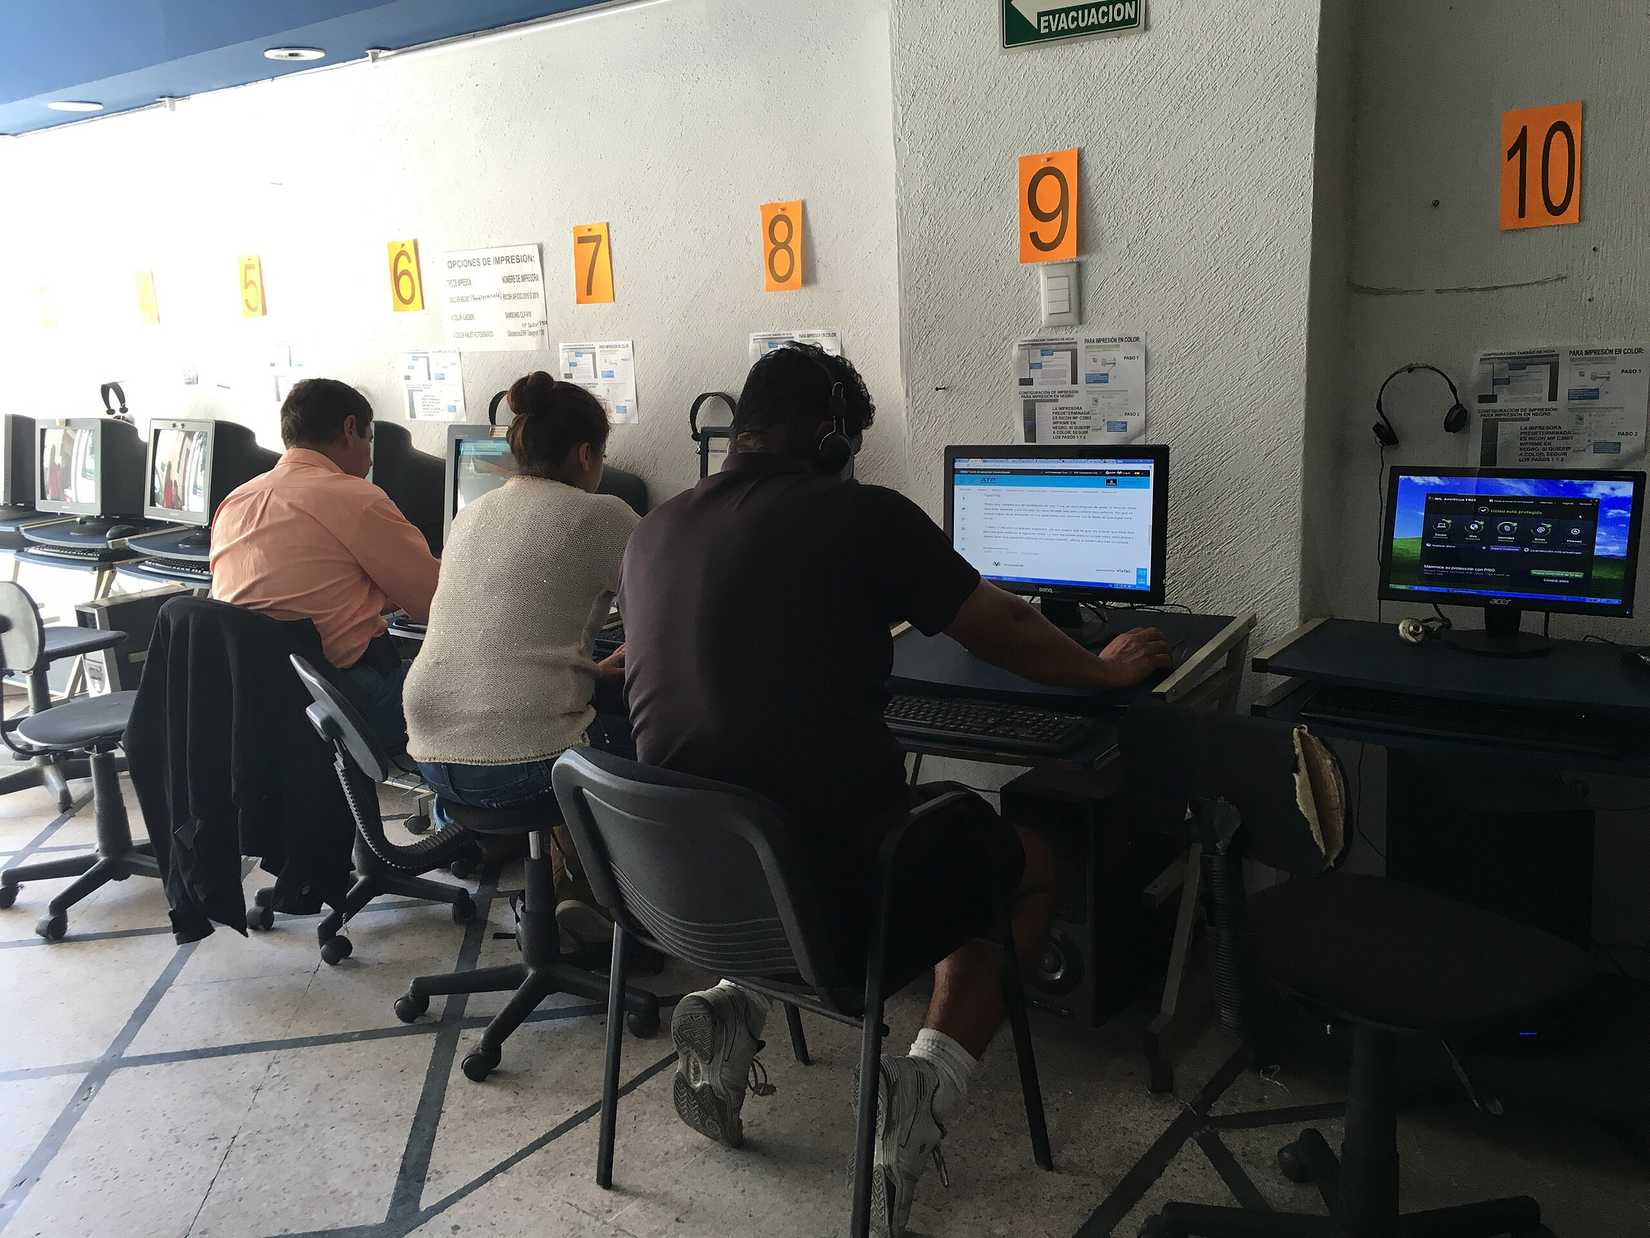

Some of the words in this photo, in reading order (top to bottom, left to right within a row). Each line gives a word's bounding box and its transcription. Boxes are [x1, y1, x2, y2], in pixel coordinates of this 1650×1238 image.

[1040, 1, 1136, 34] EVACUACION
[1507, 120, 1576, 219] 10
[1027, 166, 1069, 252] 9
[393, 250, 416, 305] 6
[447, 258, 481, 269] OPCIONES
[482, 257, 491, 266] DE
[492, 254, 535, 265] IMPRESION:
[577, 234, 602, 296] 7
[768, 214, 795, 284] 8
[244, 263, 258, 312] 5
